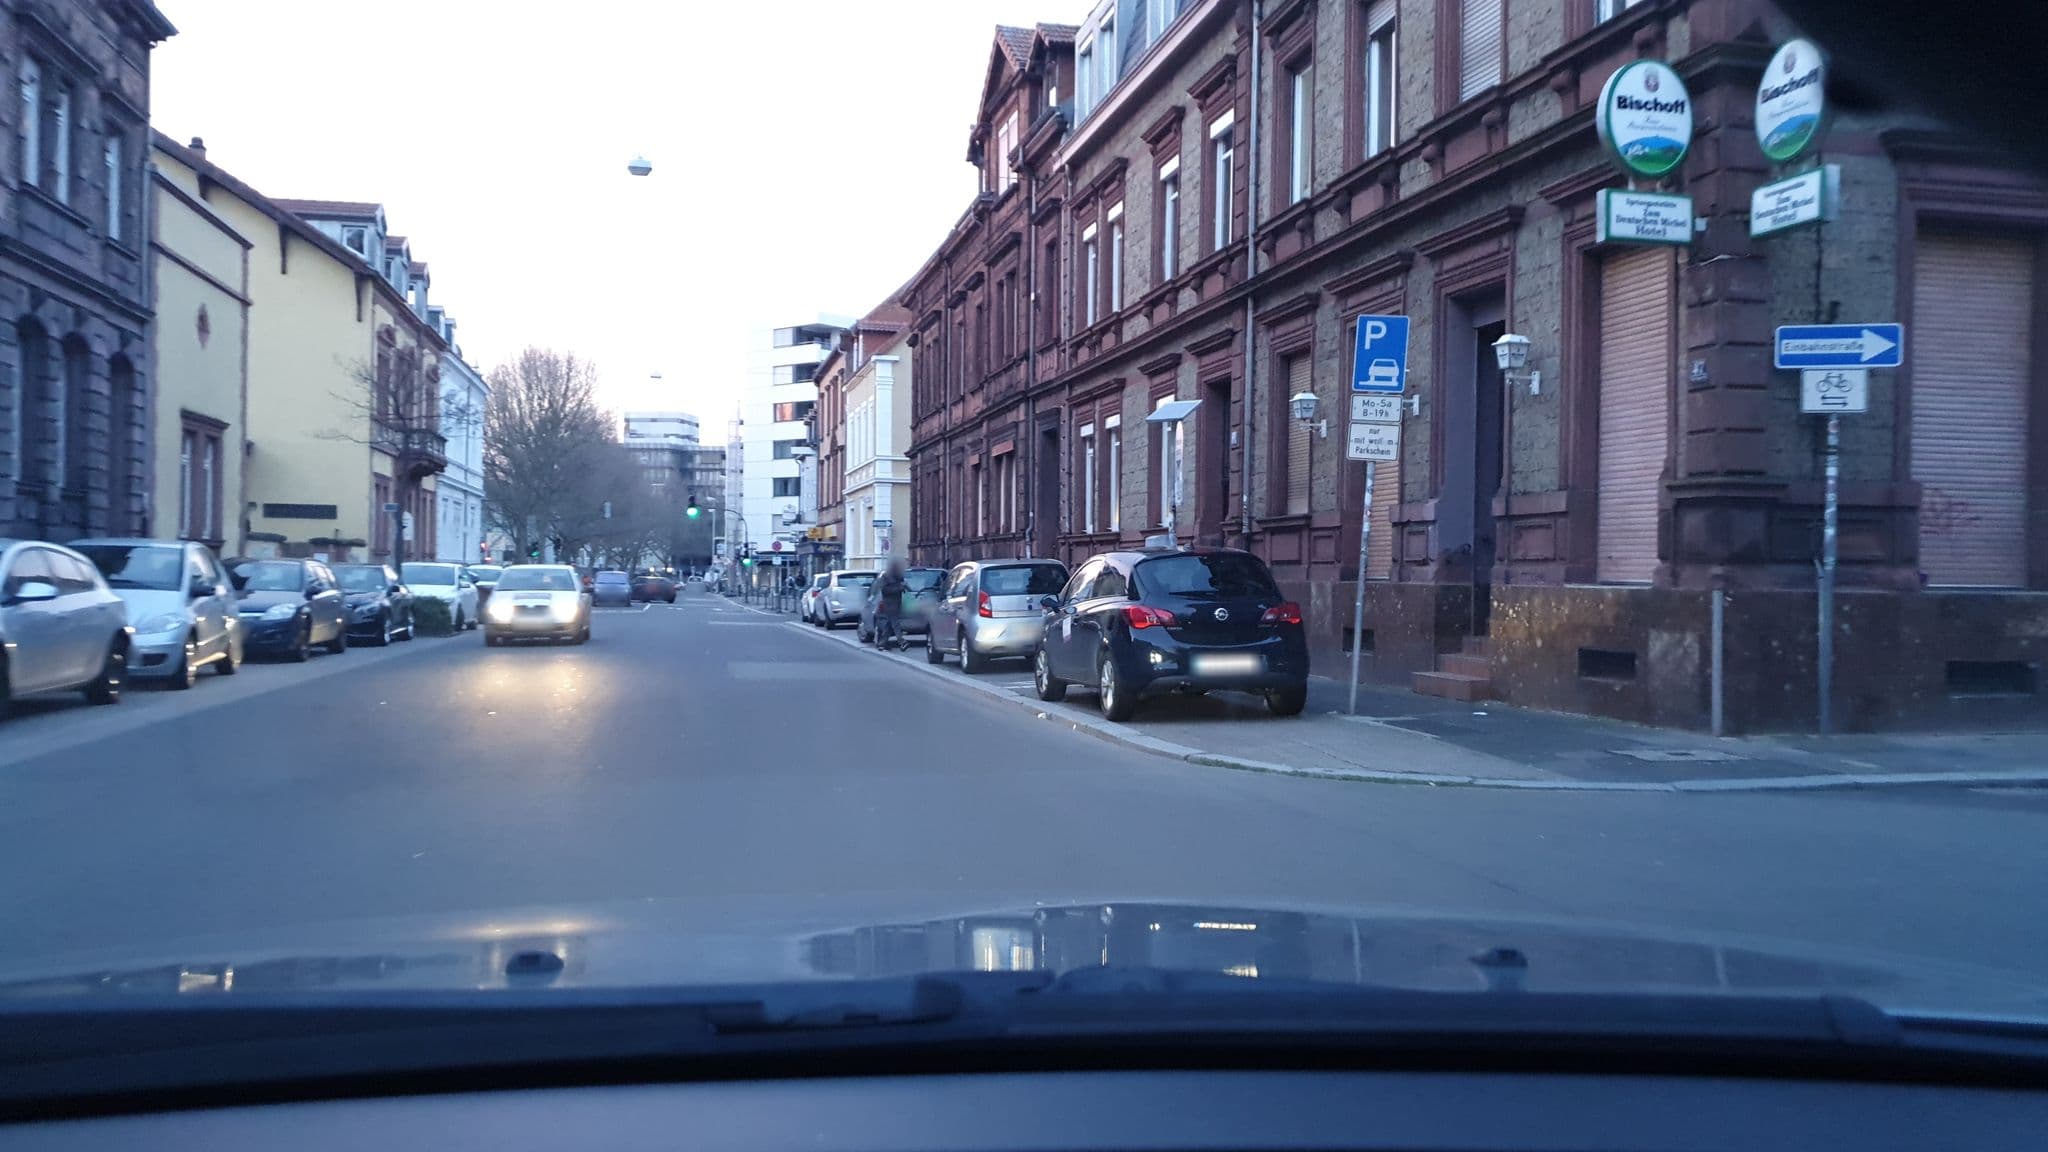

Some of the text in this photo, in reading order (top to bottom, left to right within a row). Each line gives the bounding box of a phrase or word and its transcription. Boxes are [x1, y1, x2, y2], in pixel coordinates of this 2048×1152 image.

[1761, 66, 1819, 104] Bischoff
[1617, 95, 1685, 114] Bischoff
[1635, 224, 1667, 237] Hotel
[1364, 320, 1387, 350] P
[1355, 446, 1391, 455] Parkschein
